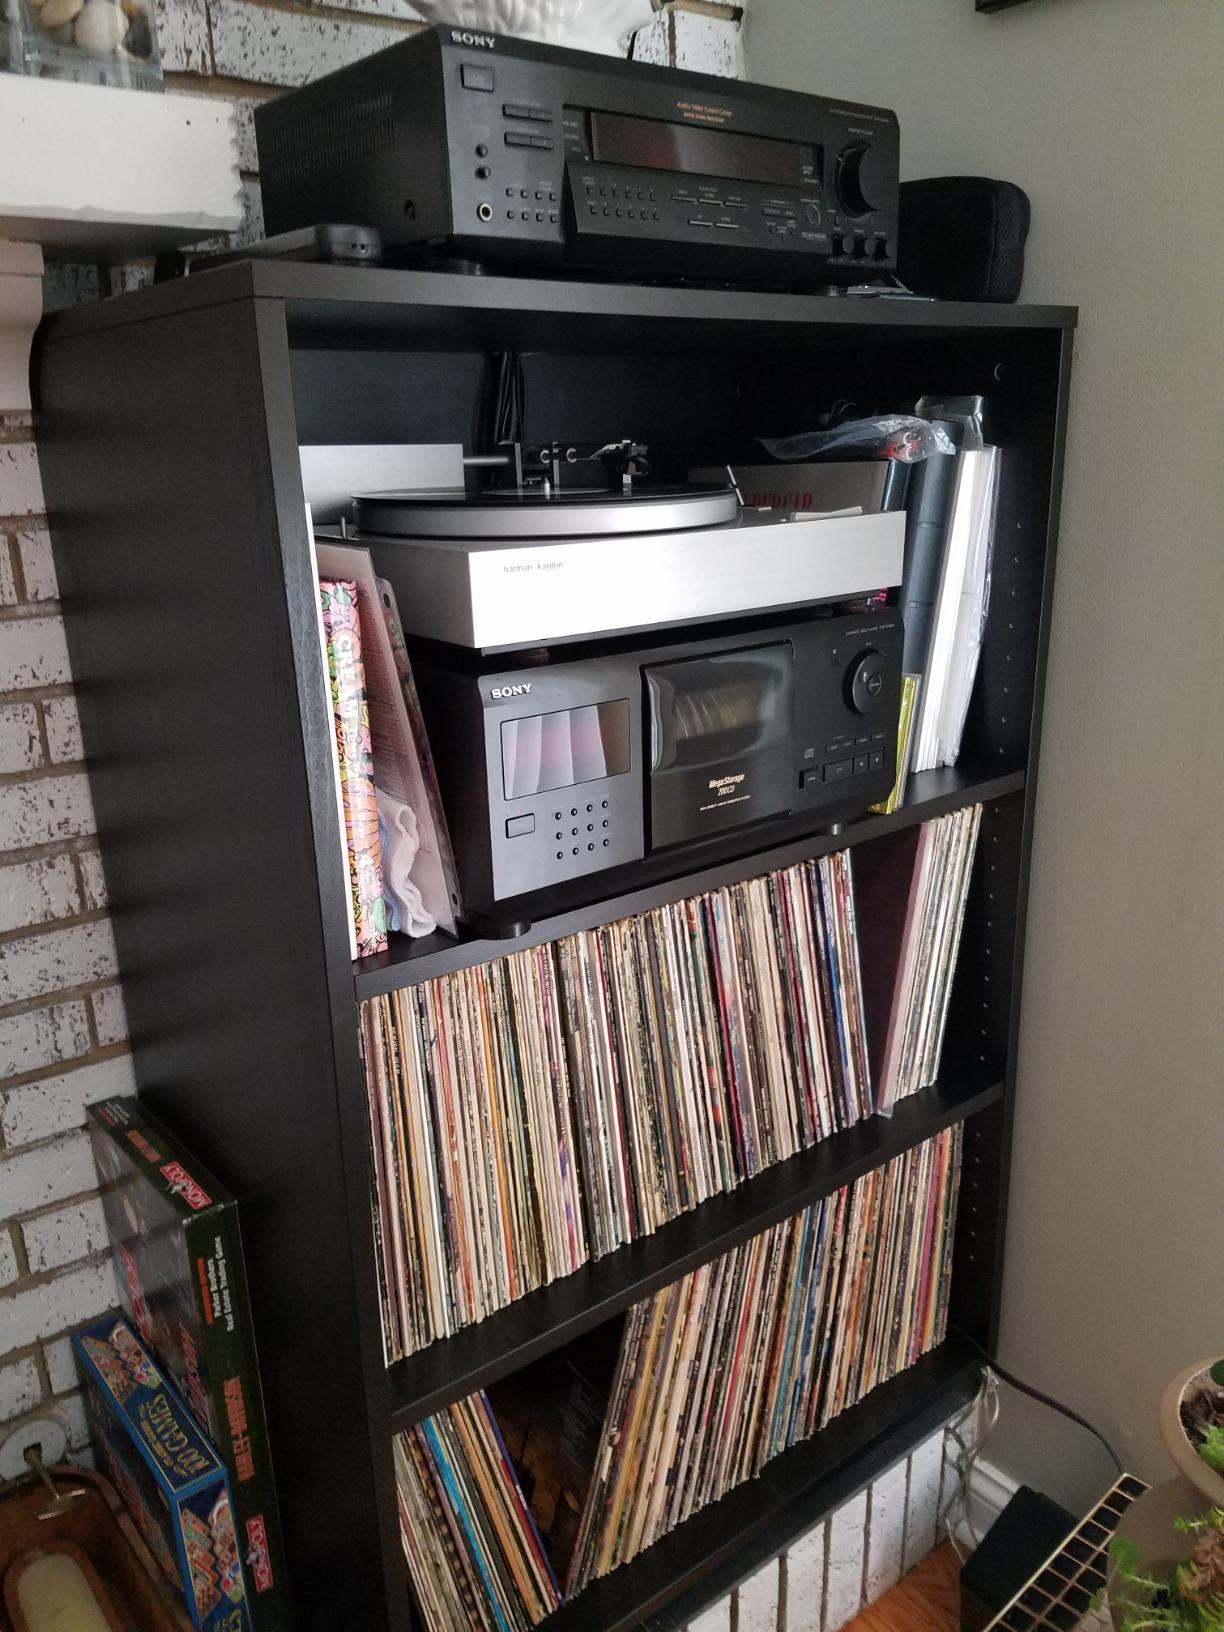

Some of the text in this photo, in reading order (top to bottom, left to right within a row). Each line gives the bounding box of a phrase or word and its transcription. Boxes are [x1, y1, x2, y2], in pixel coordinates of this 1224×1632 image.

[450, 31, 496, 49] SONY
[503, 561, 564, 574] harman kardon
[336, 634, 359, 717] CREAM
[491, 683, 532, 699] SONY
[207, 1258, 218, 1292] Brothers
[214, 1235, 235, 1332] Real Estate Trading Game
[148, 1393, 190, 1453] GAMES
